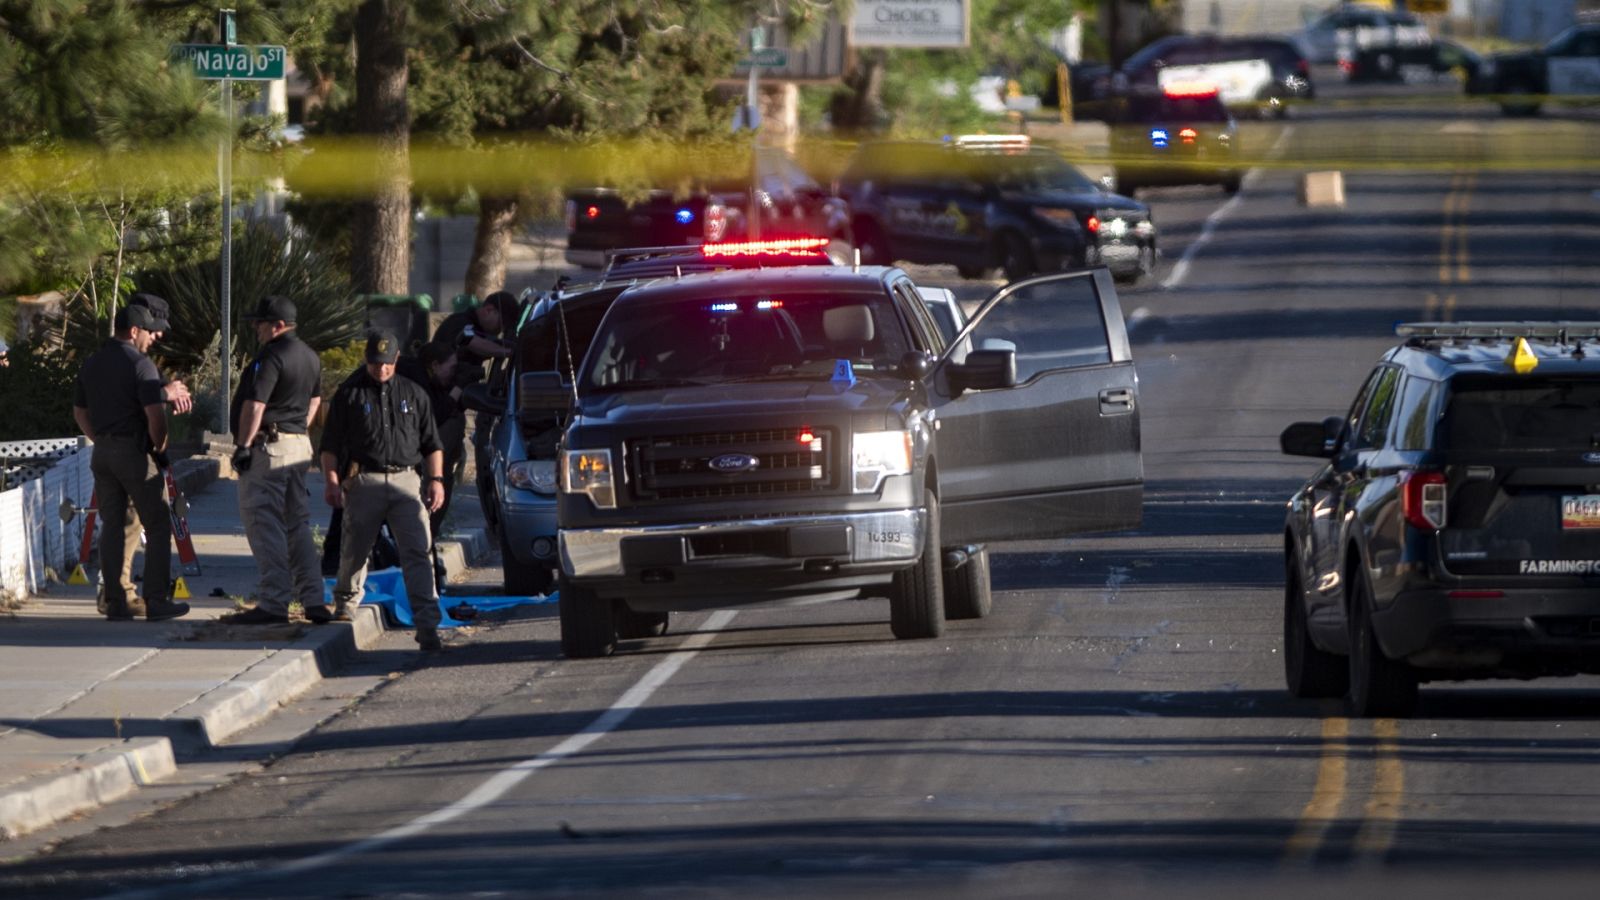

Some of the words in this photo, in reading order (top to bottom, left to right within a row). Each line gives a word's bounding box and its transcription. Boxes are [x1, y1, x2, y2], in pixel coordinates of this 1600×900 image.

[197, 49, 269, 77] Navajo
[267, 48, 282, 62] ST
[839, 364, 846, 377] 3
